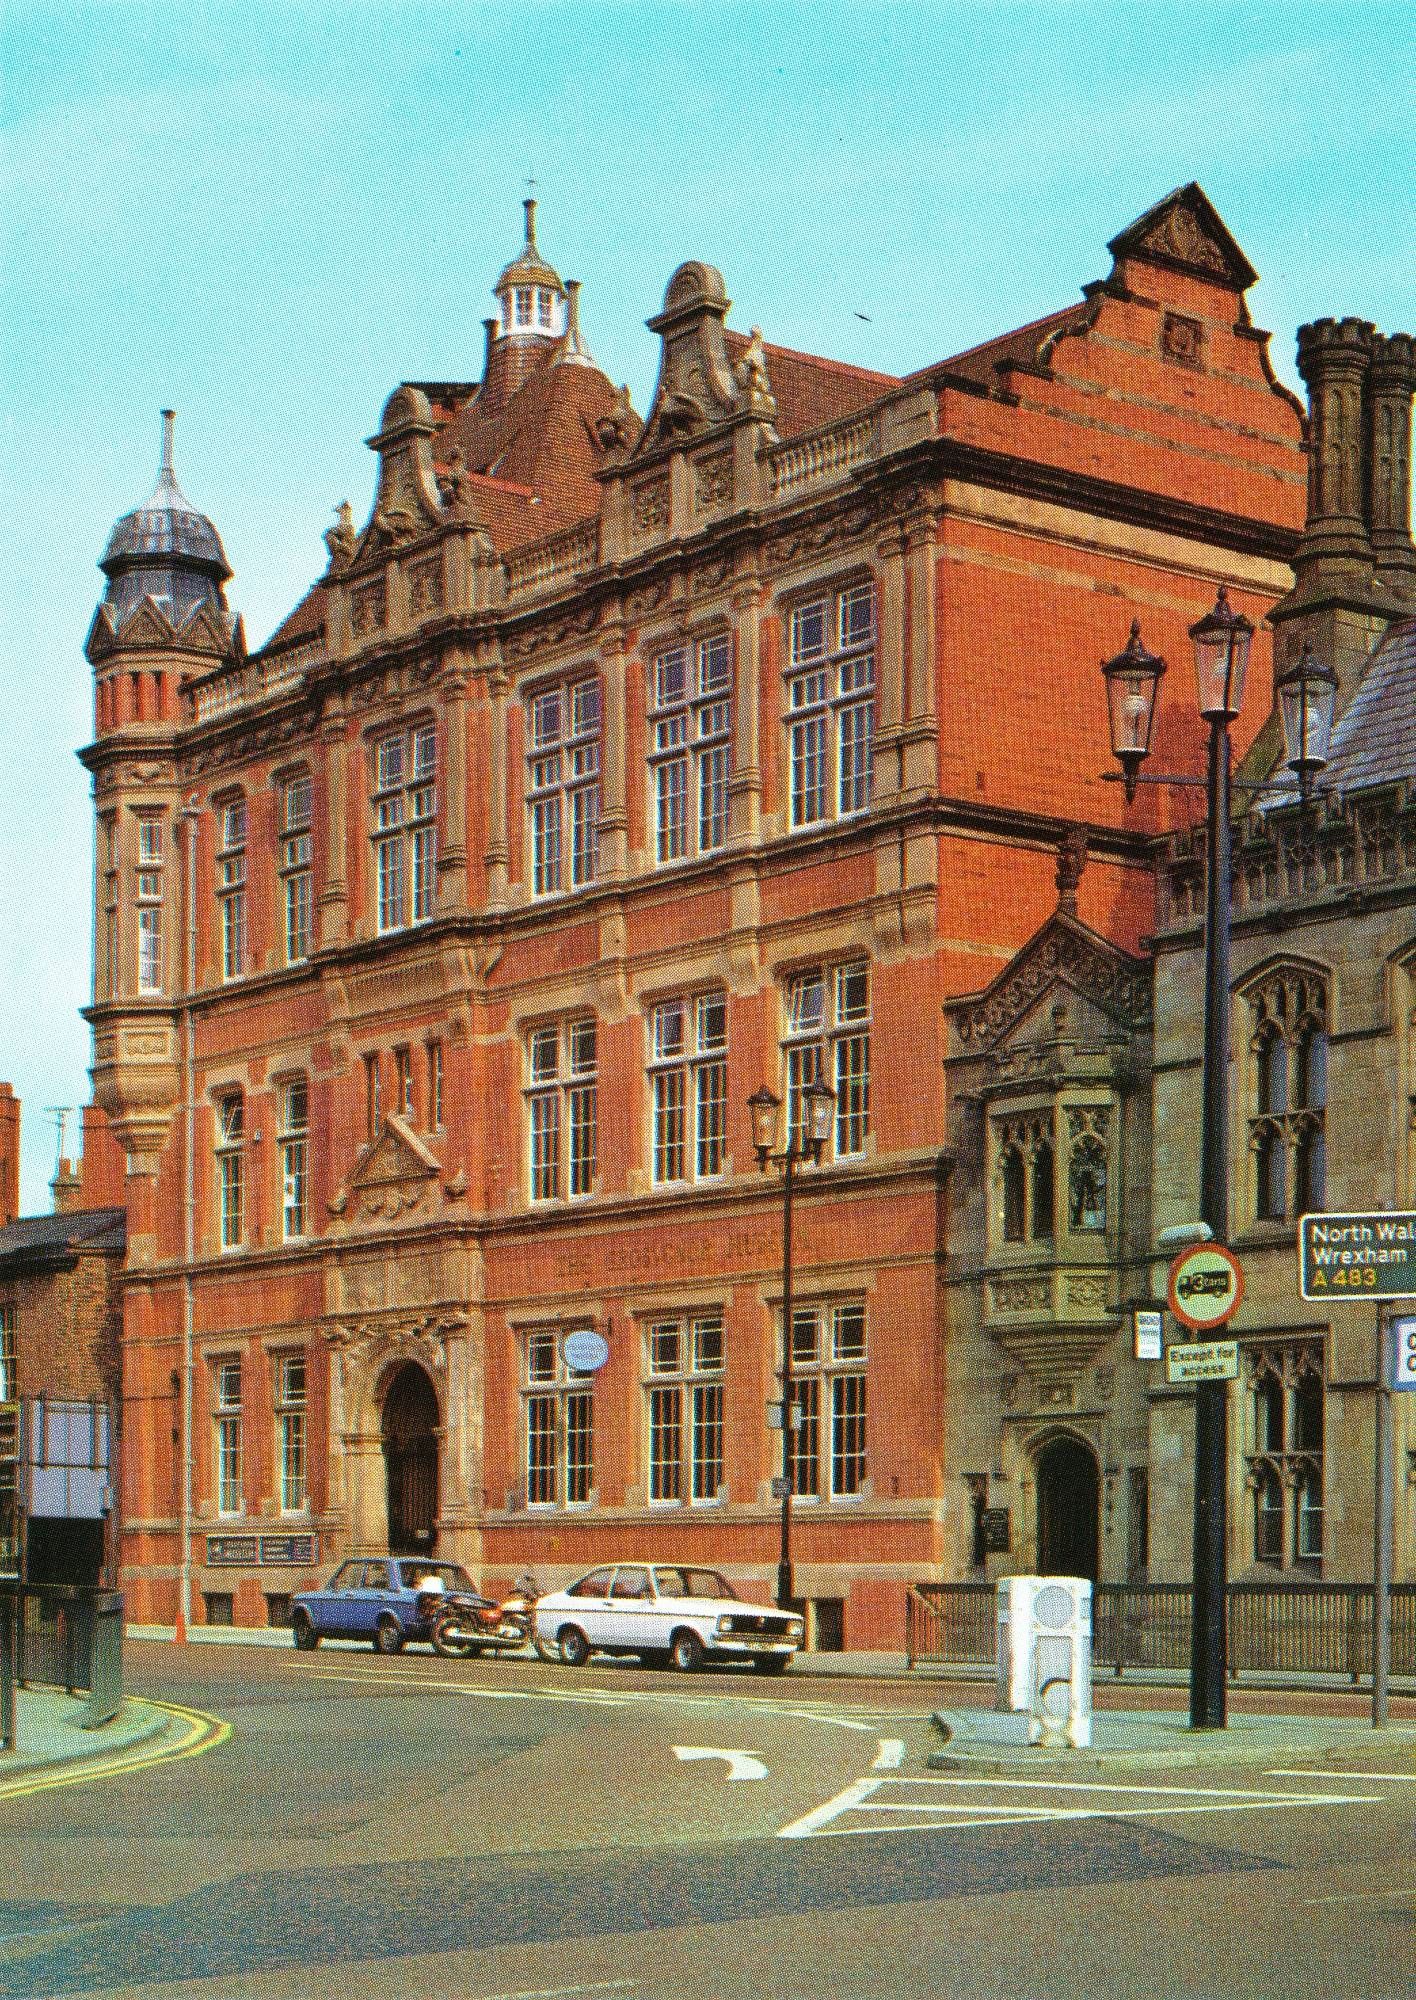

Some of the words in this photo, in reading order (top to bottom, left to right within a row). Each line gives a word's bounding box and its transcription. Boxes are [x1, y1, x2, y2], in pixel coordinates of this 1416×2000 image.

[1312, 1223, 1373, 1243] North
[1312, 1245, 1408, 1265] Wrexham
[1193, 1274, 1205, 1292] 3
[1312, 1268, 1328, 1287] A
[1332, 1267, 1377, 1287] 483
[1170, 1348, 1216, 1362] Except
[1216, 1345, 1236, 1359] for
[1181, 1364, 1226, 1377] access
